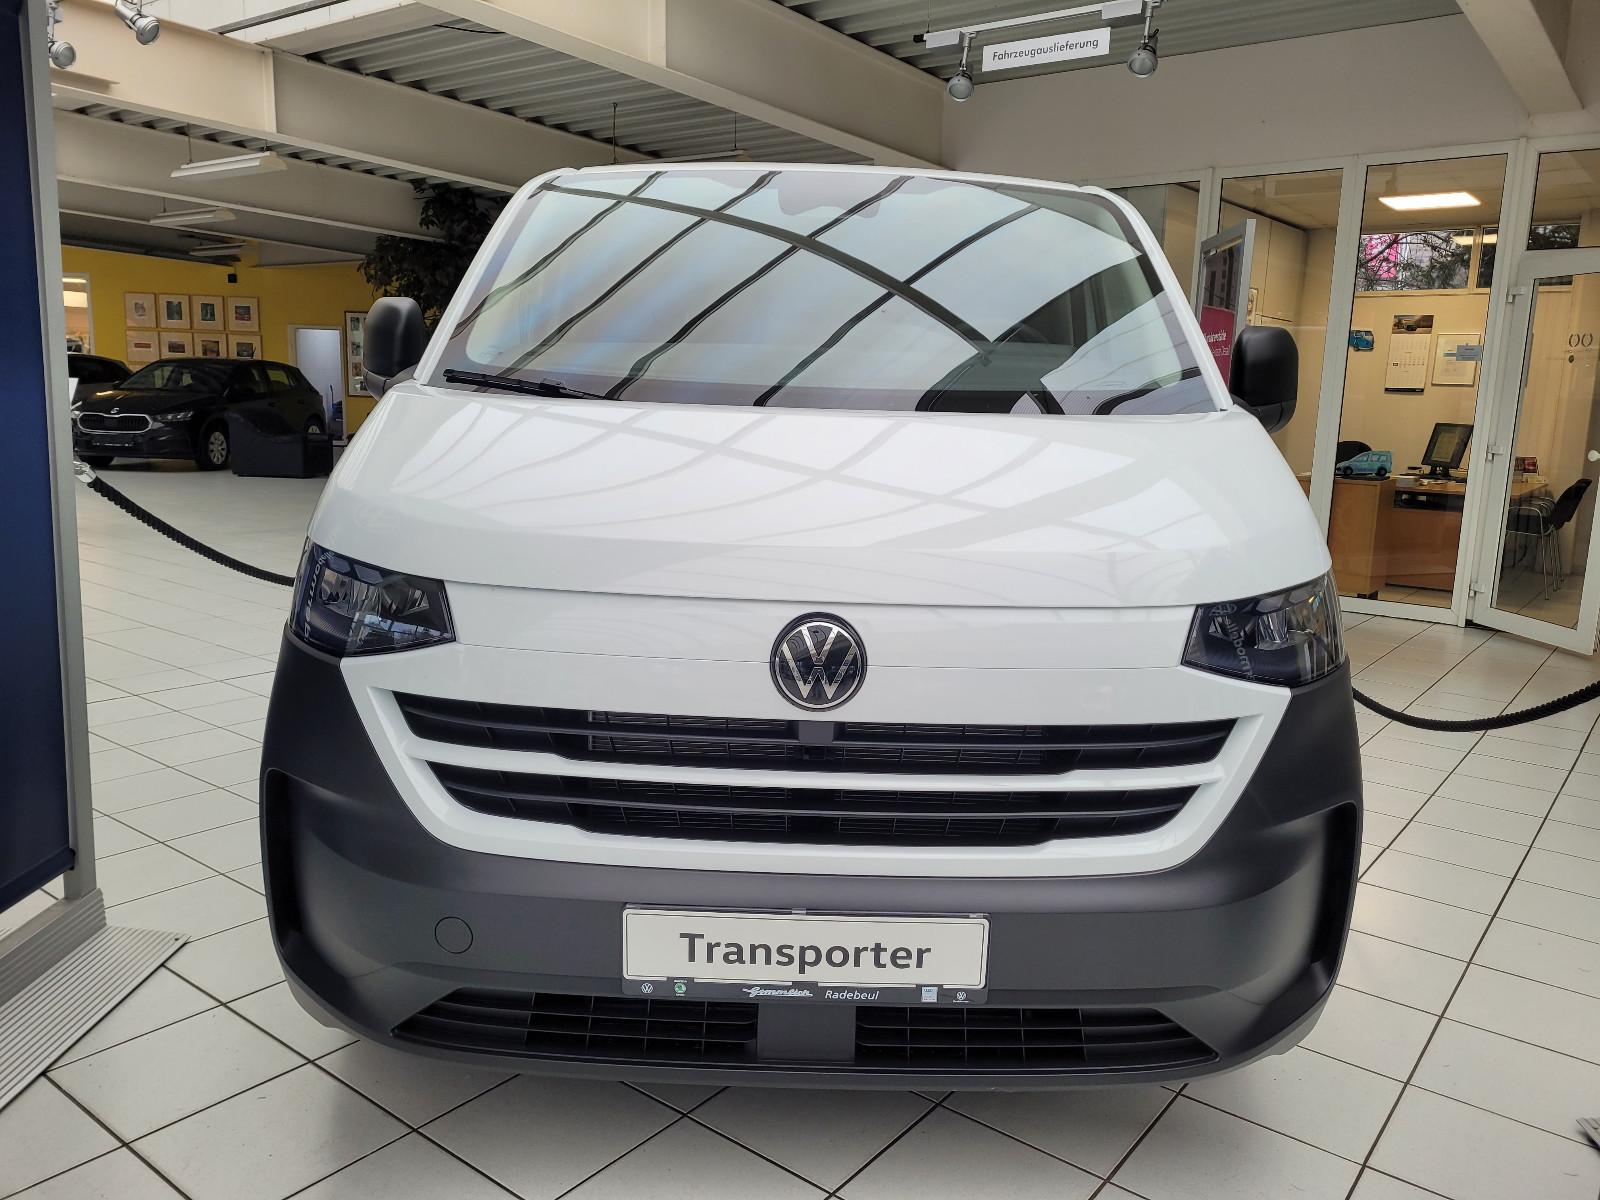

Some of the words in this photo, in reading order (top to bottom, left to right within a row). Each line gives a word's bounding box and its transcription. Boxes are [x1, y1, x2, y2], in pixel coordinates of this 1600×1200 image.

[992, 38, 1099, 61] Fahrzeugauslieferung
[679, 932, 932, 975] Transporter
[824, 990, 880, 1001] Radebeul
